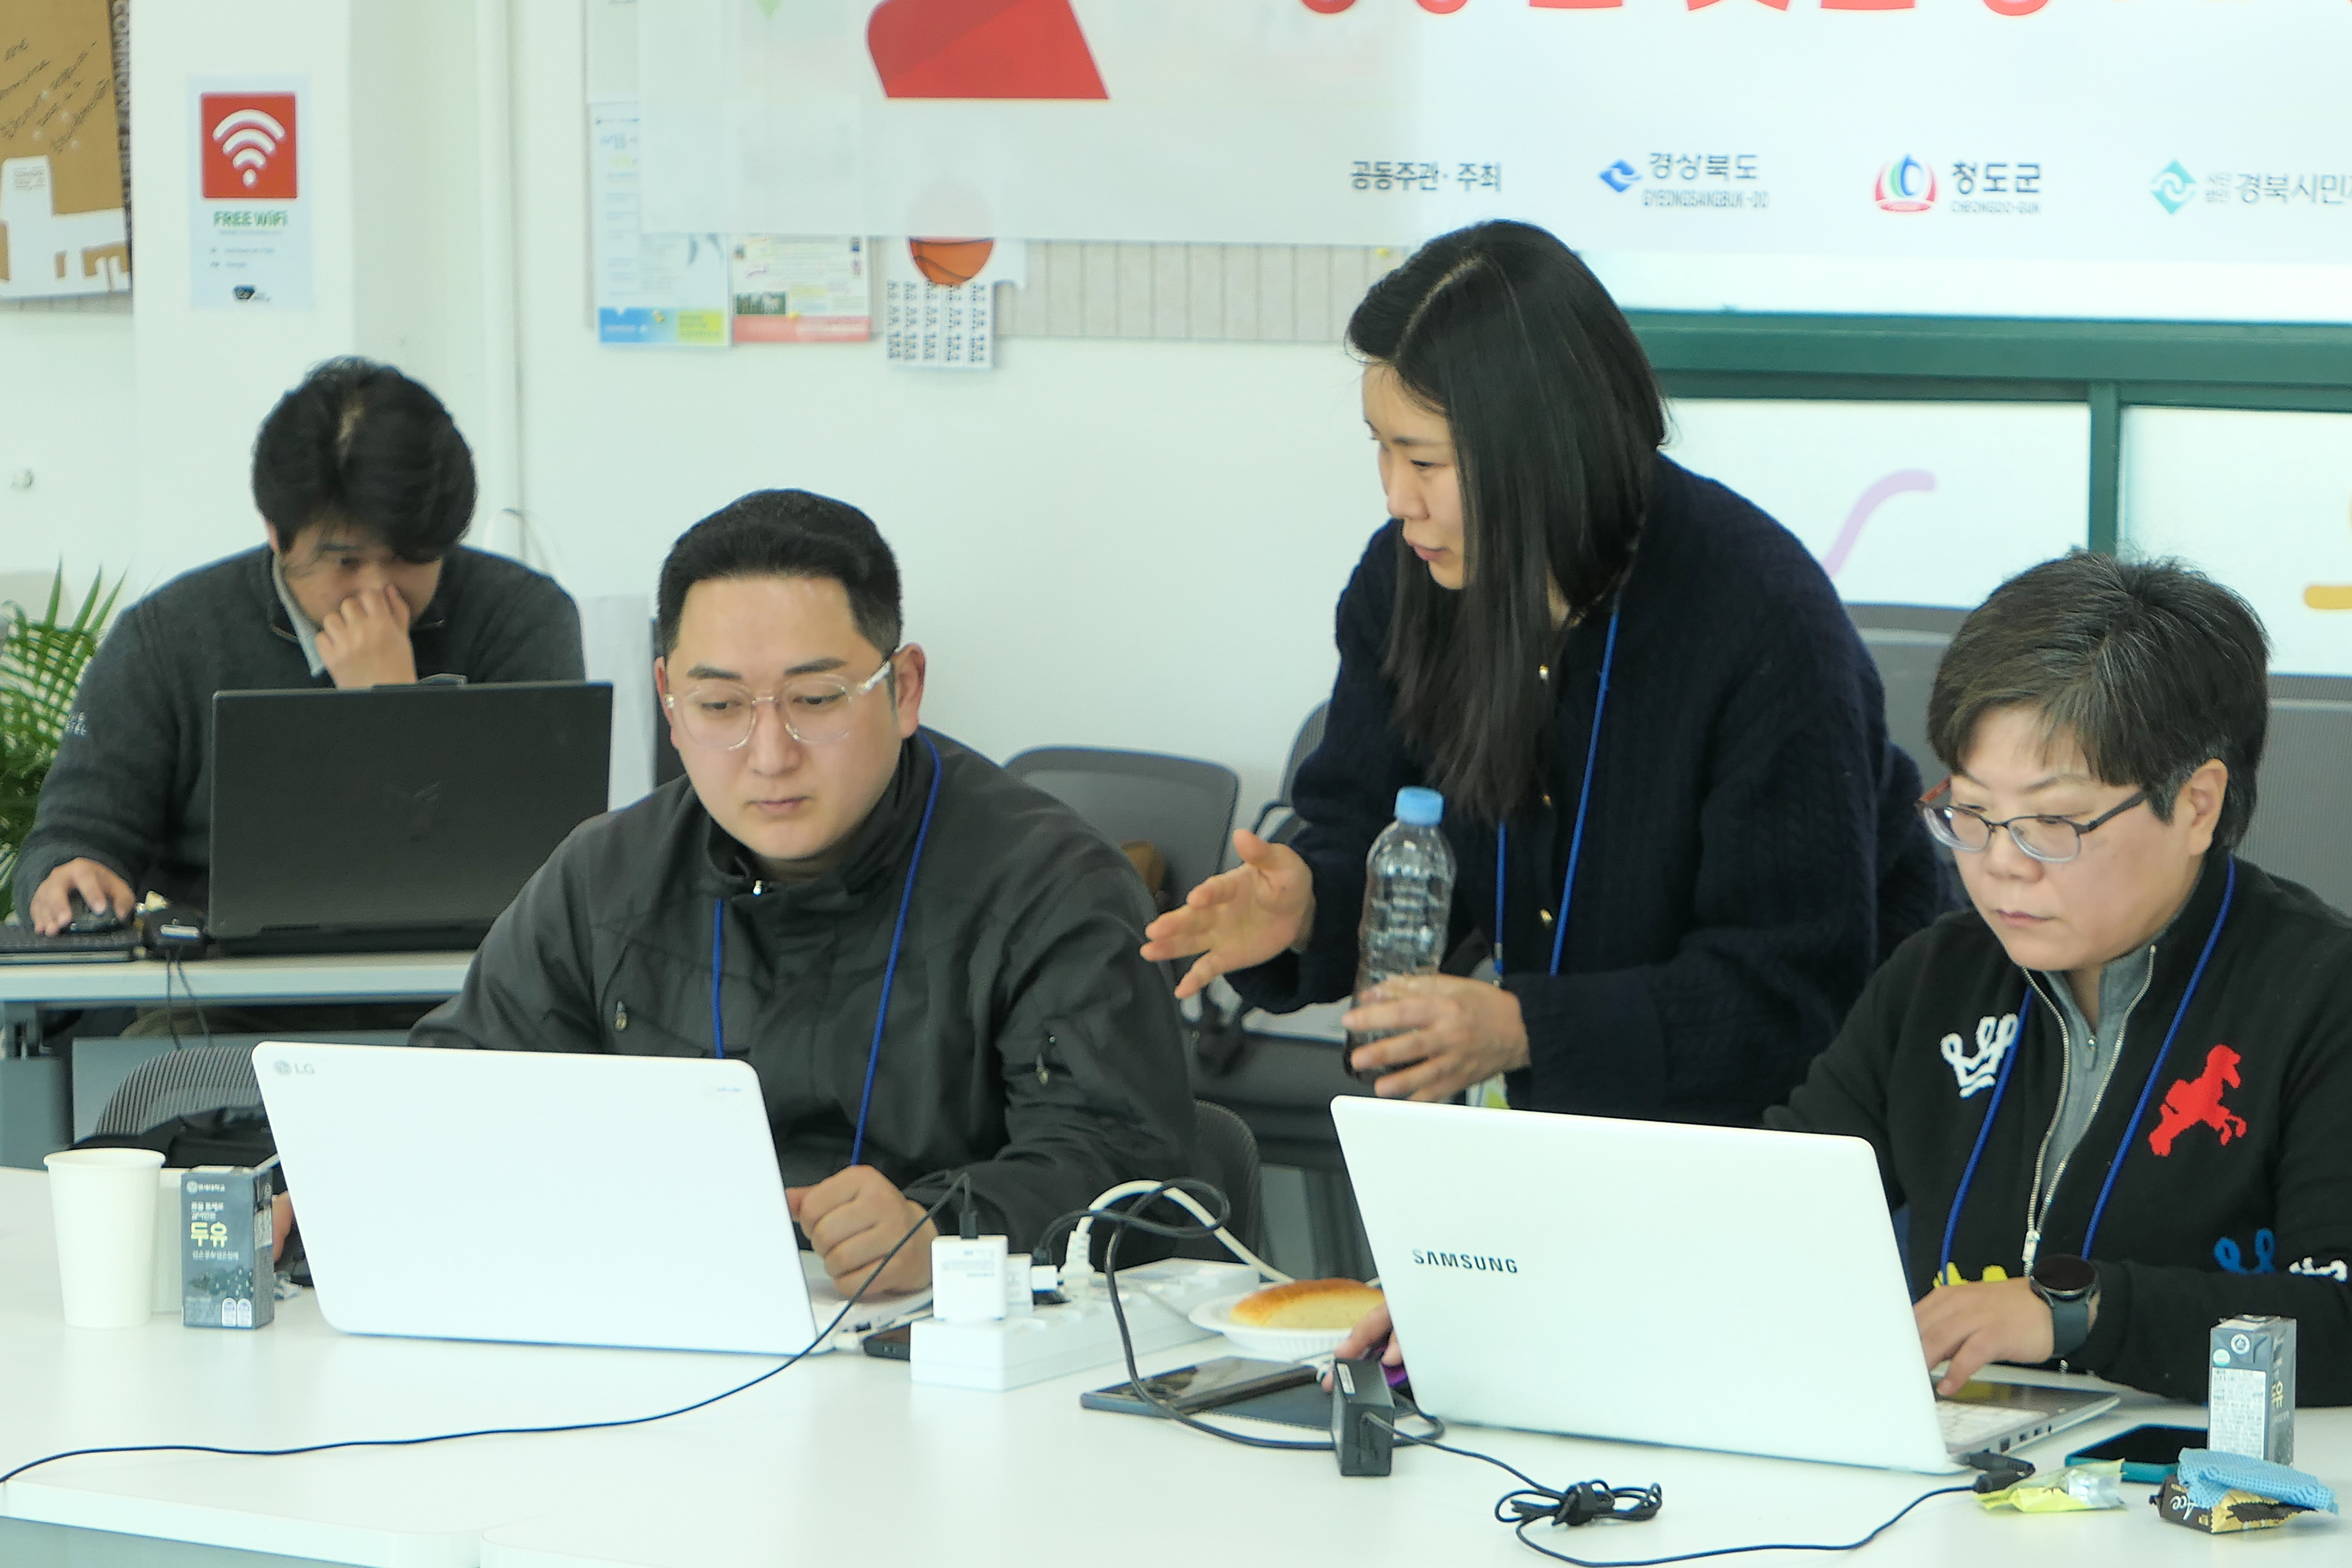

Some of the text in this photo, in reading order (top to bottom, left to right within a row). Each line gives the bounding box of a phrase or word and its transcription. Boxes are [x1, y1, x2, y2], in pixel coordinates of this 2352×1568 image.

[1457, 162, 1501, 192] 주최
[1650, 152, 1758, 181] 경상북도
[1952, 160, 2041, 195] 청도군
[2235, 173, 2352, 205] 경북시민
[214, 211, 252, 226] FREE
[294, 1062, 315, 1075] LG
[190, 1221, 228, 1248] 두유
[1412, 1249, 1518, 1274] SAMSUNG
